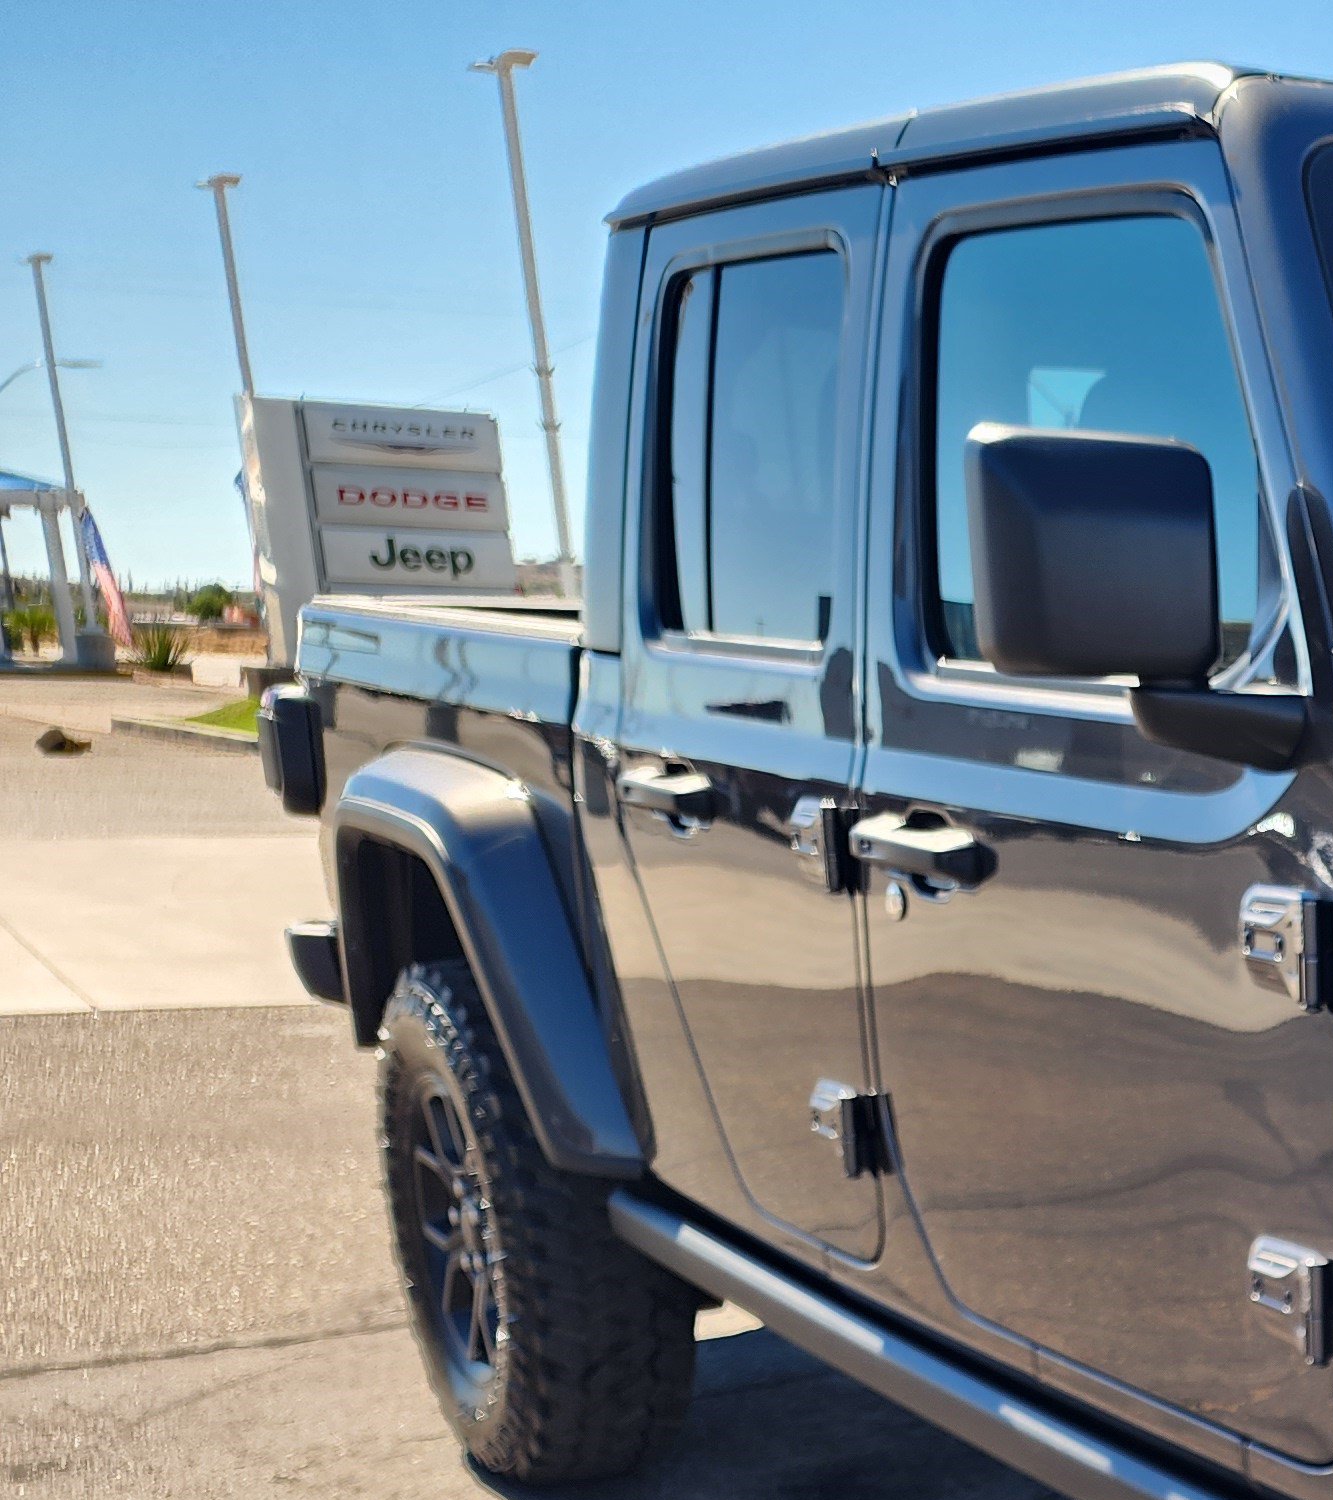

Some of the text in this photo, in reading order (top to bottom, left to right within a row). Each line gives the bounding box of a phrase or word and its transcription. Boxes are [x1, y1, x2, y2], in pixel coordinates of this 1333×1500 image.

[331, 416, 476, 440] CHRYSLER
[337, 484, 489, 513] DODGE
[368, 533, 477, 580] Jeep
